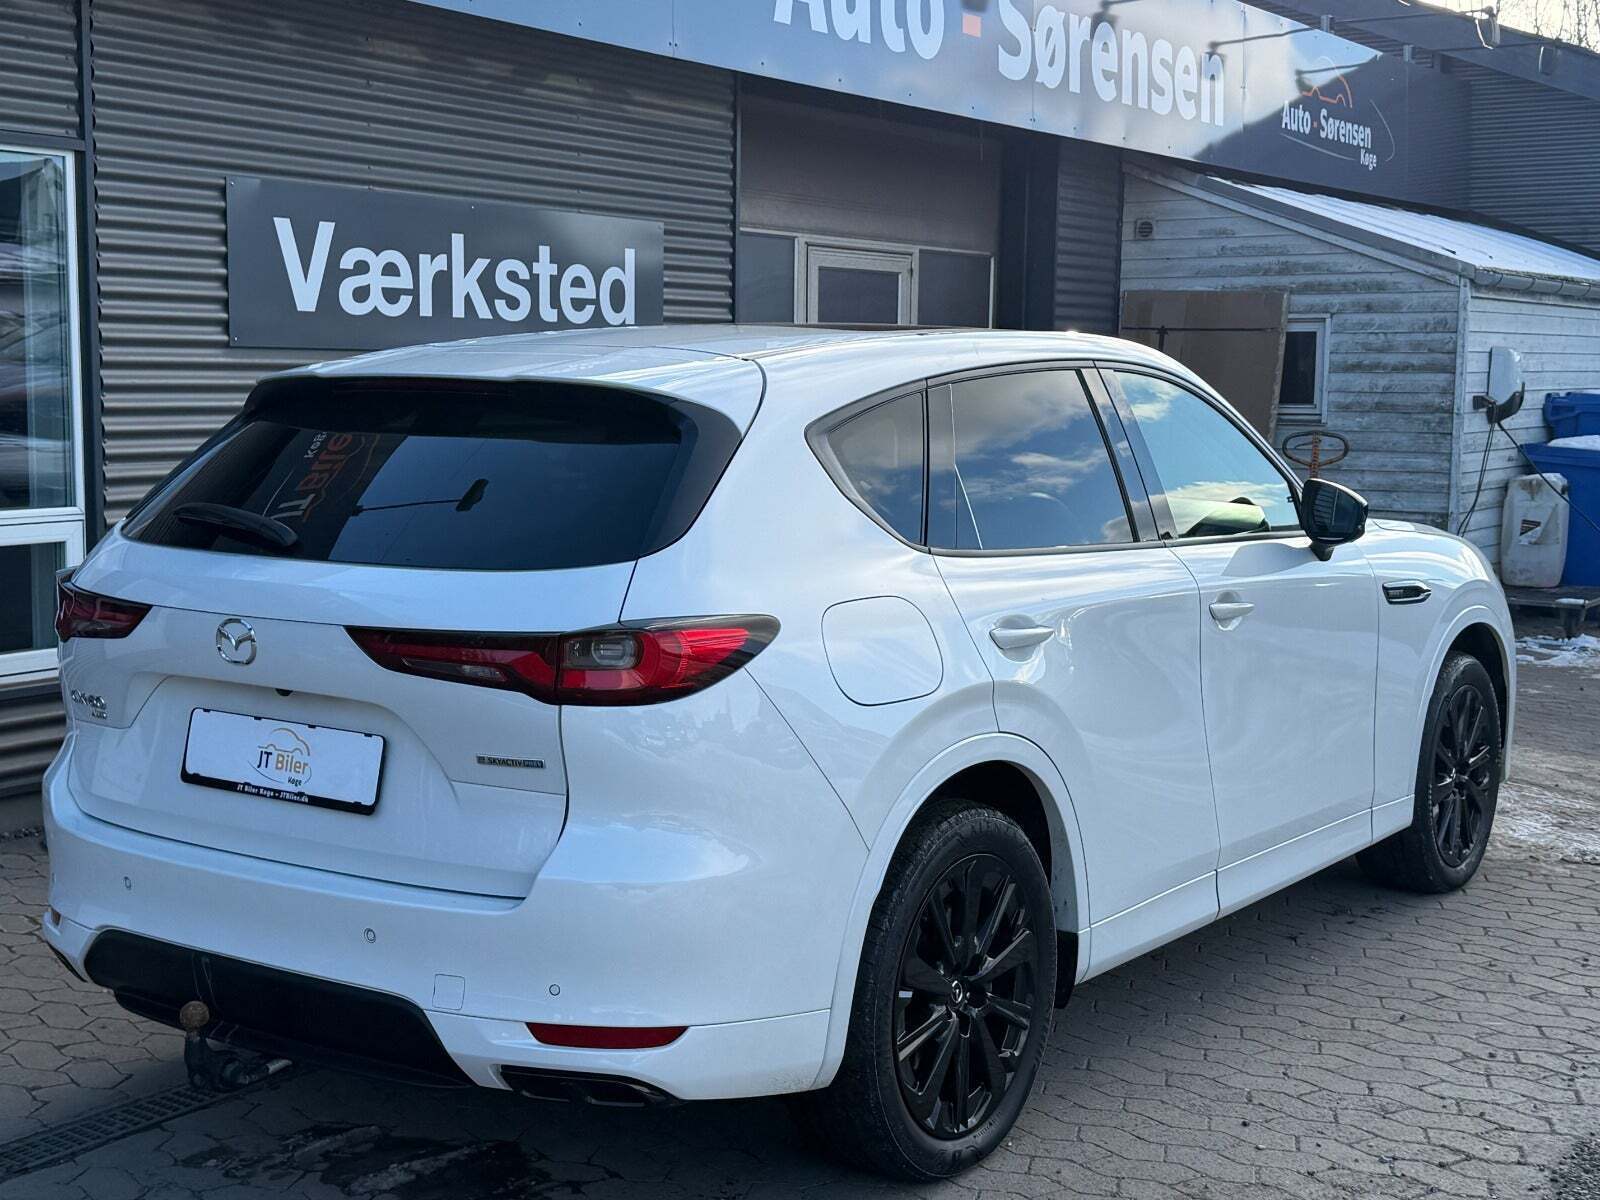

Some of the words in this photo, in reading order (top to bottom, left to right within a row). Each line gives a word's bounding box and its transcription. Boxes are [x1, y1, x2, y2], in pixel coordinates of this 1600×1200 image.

[773, 0, 945, 60] uto
[998, 0, 1225, 126] Sørensen
[1281, 100, 1311, 134] Auto
[1319, 107, 1371, 149] Sørensen
[1360, 148, 1377, 171] Køge
[272, 216, 636, 326] Værksted
[257, 750, 273, 769] JT
[275, 752, 309, 775] Biler
